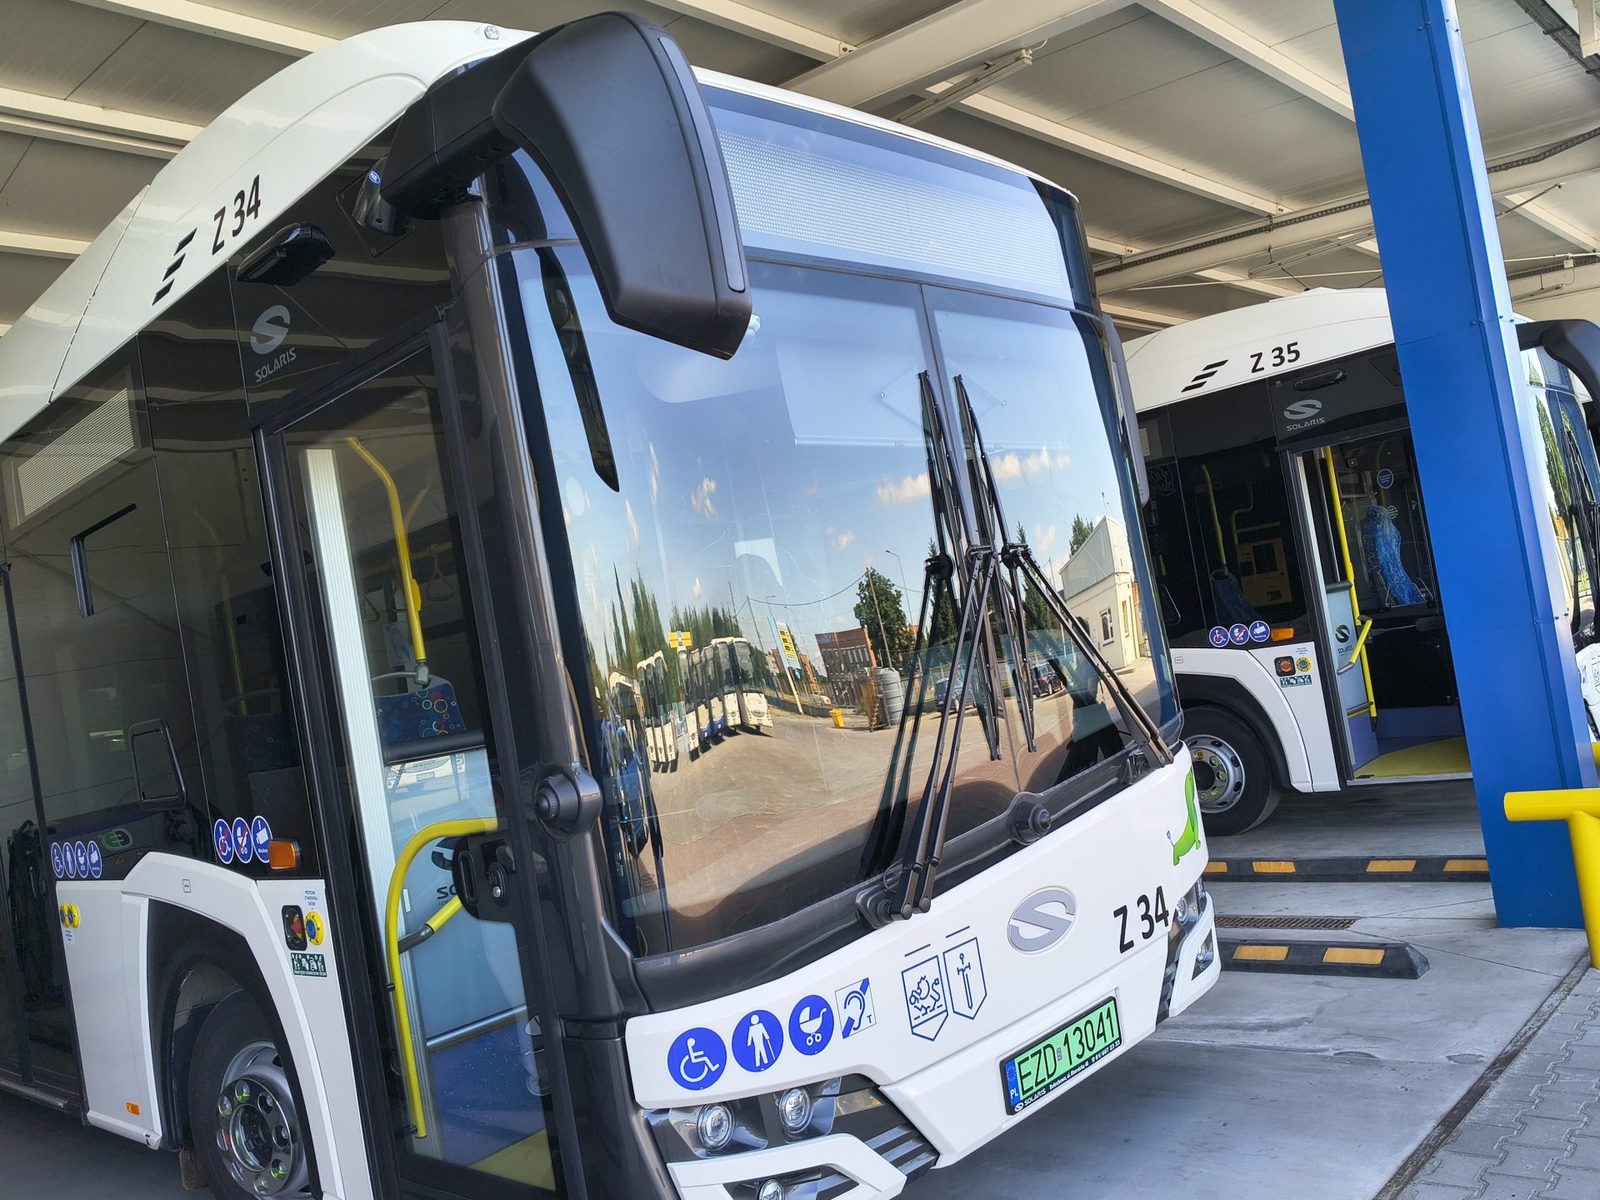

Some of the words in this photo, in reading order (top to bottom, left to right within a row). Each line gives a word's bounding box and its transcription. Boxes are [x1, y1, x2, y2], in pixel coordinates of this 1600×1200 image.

[212, 206, 226, 255] Z
[232, 174, 260, 237] 34
[255, 347, 297, 383] SOLARIS
[1250, 352, 1265, 373] Z
[1271, 341, 1300, 367] 35
[1286, 417, 1326, 431] SOLARIS
[1113, 904, 1135, 954] Z
[1136, 885, 1169, 940] 34
[866, 1014, 873, 1024] T
[1017, 1043, 1057, 1096] EZD
[1063, 1006, 1115, 1066] 13041
[1010, 1088, 1019, 1099] PL
[1024, 1088, 1047, 1106] SOLARIS
